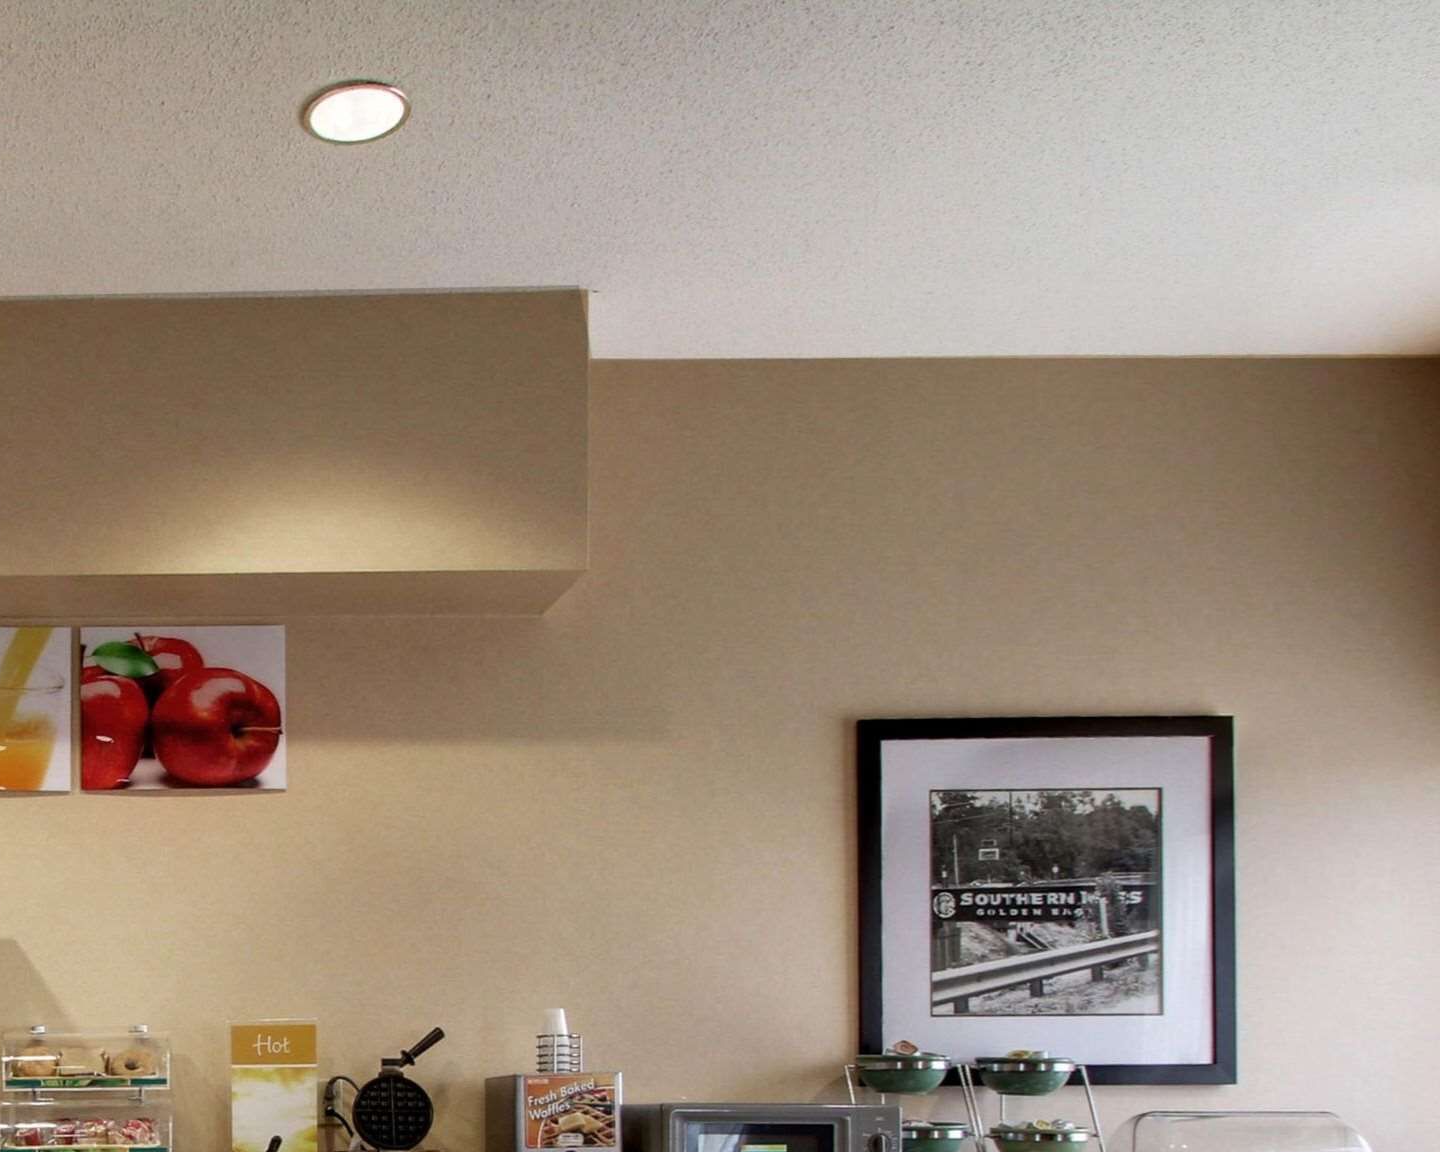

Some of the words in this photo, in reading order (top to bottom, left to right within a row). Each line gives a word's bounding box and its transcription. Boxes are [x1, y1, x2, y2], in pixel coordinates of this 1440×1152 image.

[960, 892, 1076, 907] SOUTHERN
[976, 908, 1043, 917] GOLDEN
[252, 1033, 291, 1057] Hot
[527, 1090, 557, 1107] Fresh
[560, 1078, 595, 1097] Baked
[528, 1102, 571, 1120] Waffles
